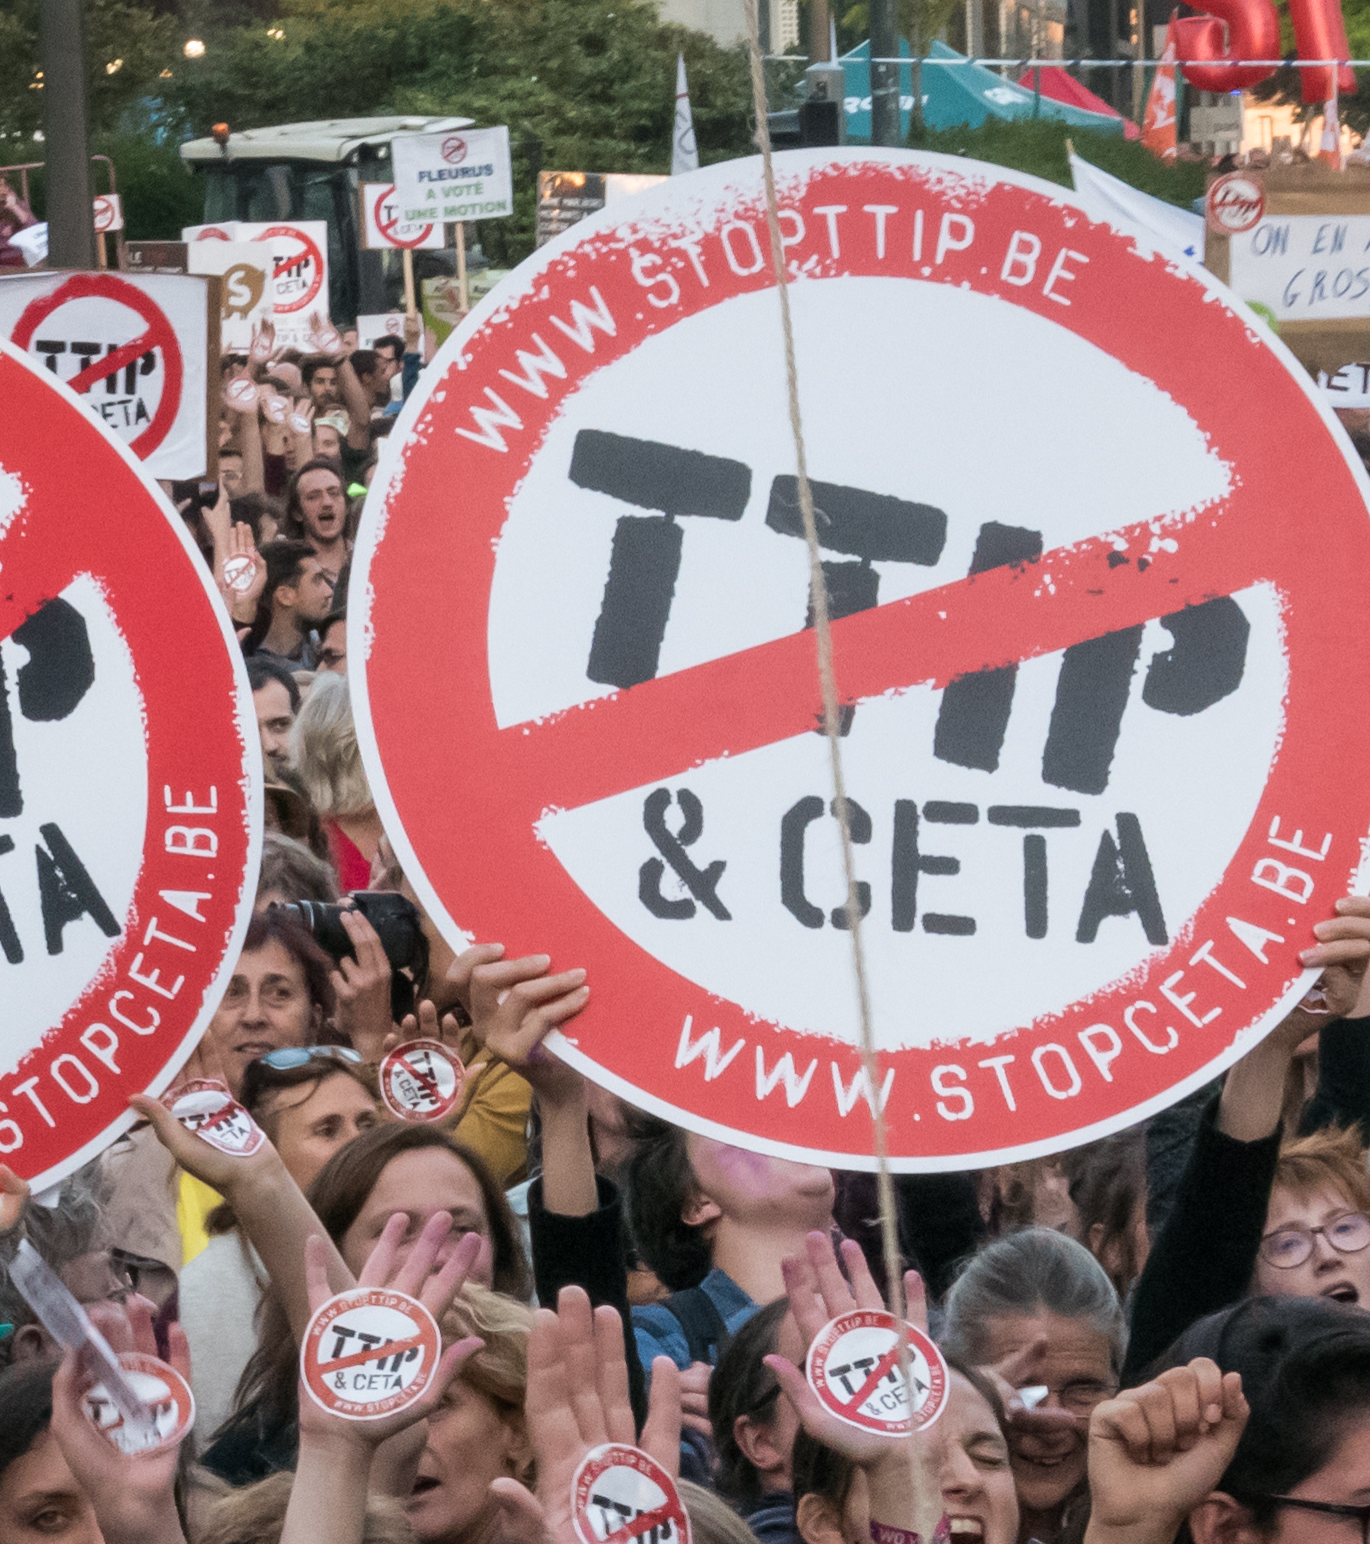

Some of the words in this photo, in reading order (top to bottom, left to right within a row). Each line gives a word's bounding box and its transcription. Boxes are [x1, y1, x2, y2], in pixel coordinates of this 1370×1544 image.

[418, 164, 494, 183] FLEURUS
[404, 207, 438, 221] UNE
[442, 200, 508, 218] MOTION
[1250, 224, 1291, 257] ON
[1312, 224, 1348, 254] EN
[36, 340, 156, 395] TTIP
[91, 397, 151, 429] ETA
[567, 427, 1251, 797] TTIP
[638, 788, 732, 921] &
[779, 795, 1170, 946] CETA
[331, 1325, 419, 1373] TTIP
[335, 1372, 347, 1390] &
[352, 1374, 404, 1391] CETA
[881, 1377, 930, 1412] CEA
